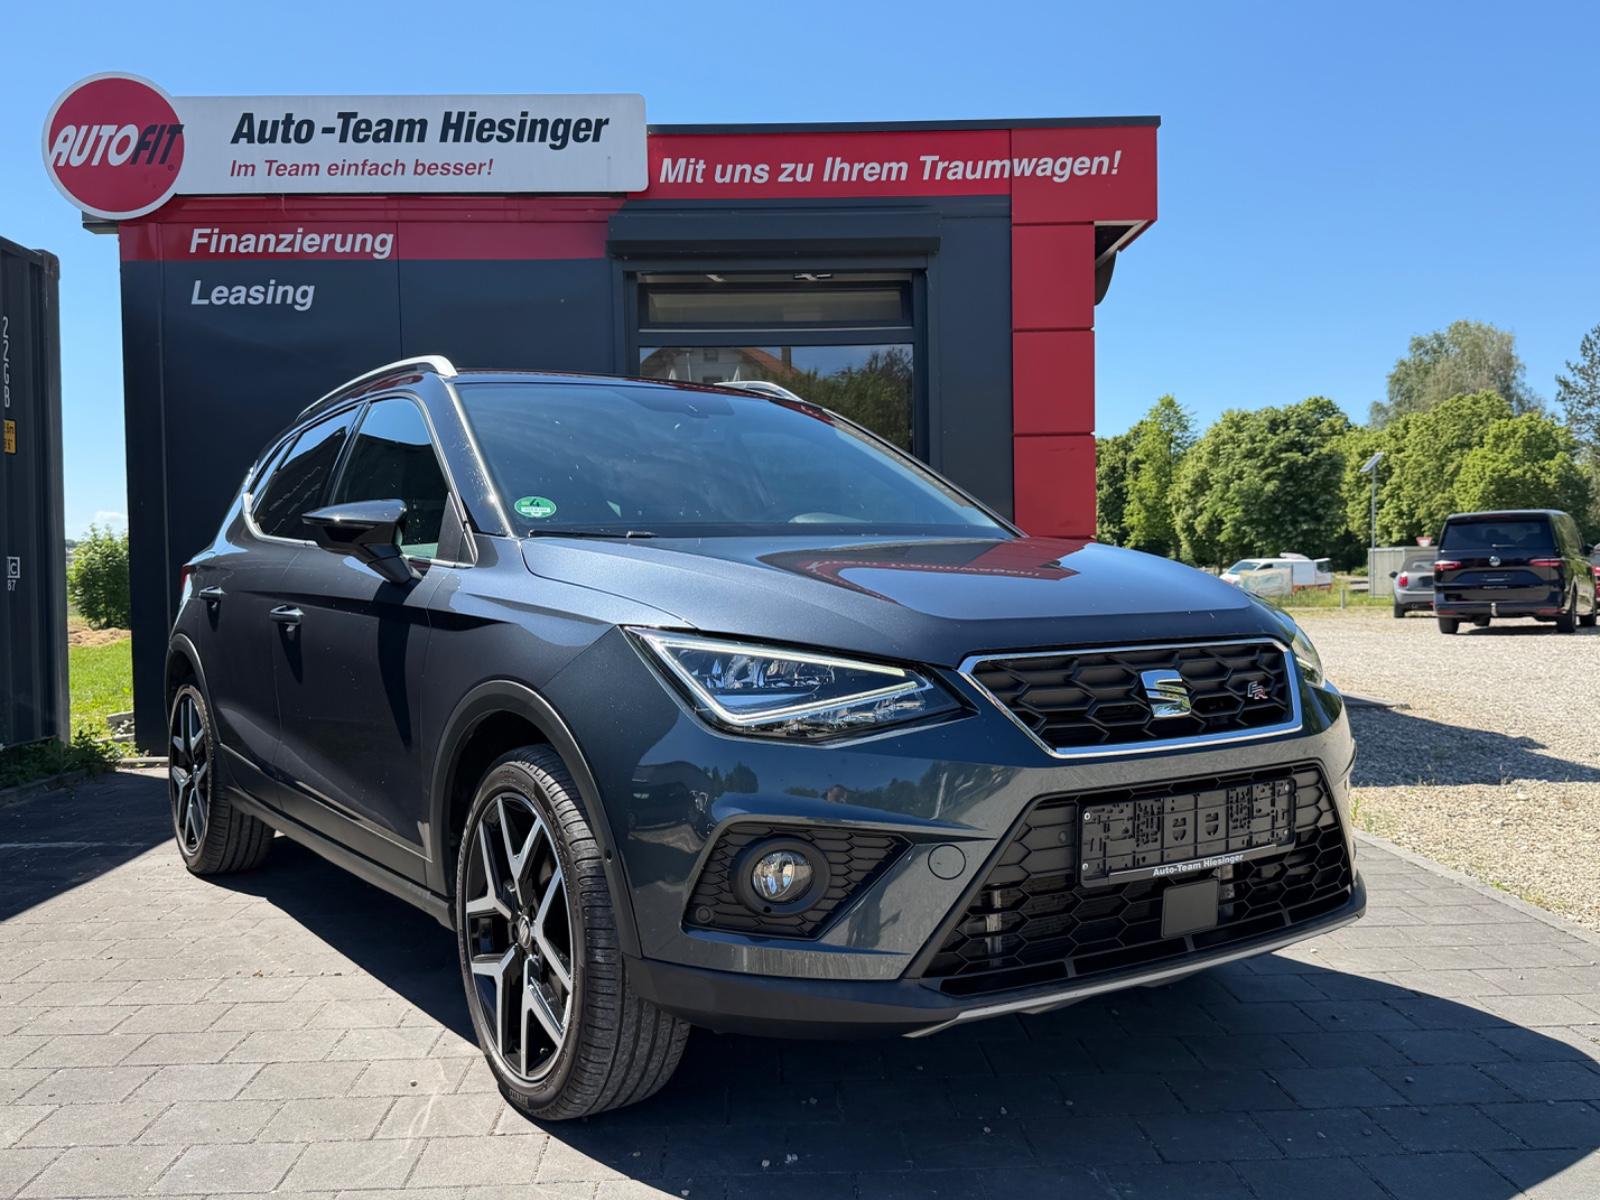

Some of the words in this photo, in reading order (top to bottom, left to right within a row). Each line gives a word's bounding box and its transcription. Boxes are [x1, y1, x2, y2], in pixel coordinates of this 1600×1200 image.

[50, 123, 185, 167] AUTOFIT
[439, 111, 610, 151] Hiesinger
[230, 159, 256, 177] Im
[264, 159, 320, 177] Team
[326, 158, 406, 177] einfach
[413, 158, 494, 177] besser!
[659, 157, 706, 184] Mit
[714, 163, 770, 184] uns
[778, 162, 815, 183] zu
[823, 157, 909, 182] Ihrem
[919, 150, 1122, 183] Traumwagen!
[189, 227, 394, 260] Finanzierung
[191, 279, 316, 311] Leasing
[1152, 863, 1201, 877] Auto-Team
[1203, 854, 1244, 868] Hiesinger
